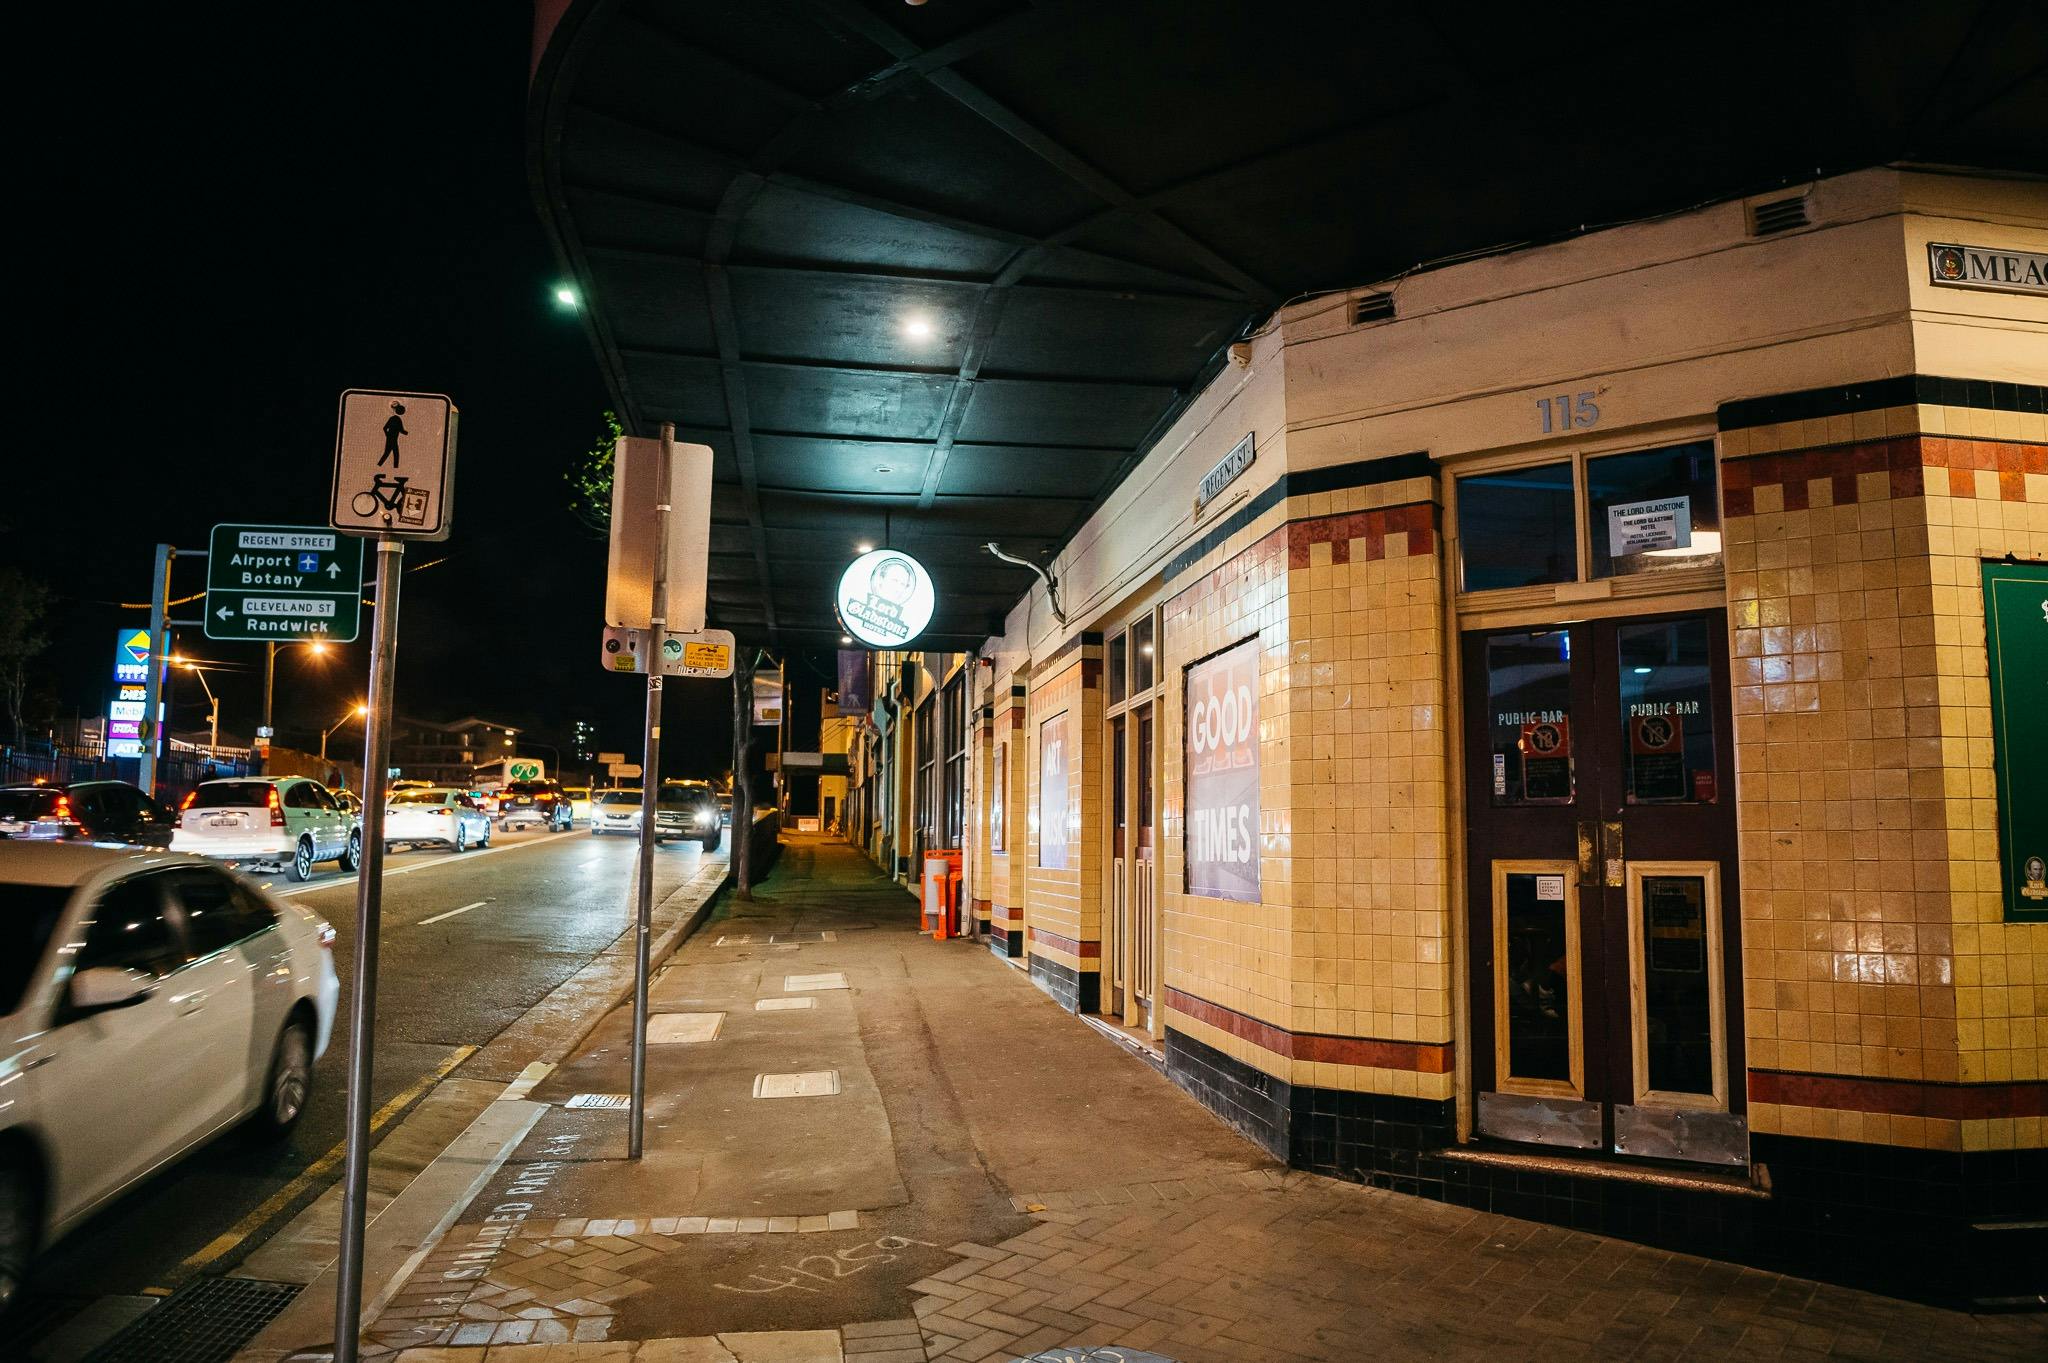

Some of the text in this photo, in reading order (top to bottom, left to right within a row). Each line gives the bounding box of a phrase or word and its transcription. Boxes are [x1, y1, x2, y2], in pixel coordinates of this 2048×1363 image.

[1969, 253, 2048, 286] MEA
[1536, 391, 1600, 433] 115
[1205, 443, 1247, 499] REGENT ST
[1613, 501, 1685, 517] THE LORD GLADSTONE
[242, 535, 332, 547] REGENT STREET
[230, 553, 291, 568] Airport
[241, 571, 304, 588] Botany
[246, 601, 332, 613] CLEVELAND ST
[247, 618, 329, 633] Randwick
[1630, 700, 1700, 717] PUBLIC BAR
[1191, 684, 1252, 754] GOOD
[1498, 710, 1564, 726] PUBLIC BAR
[1046, 740, 1062, 777] ART
[1194, 803, 1251, 864] TIMES
[505, 1161, 562, 1195] PATH
